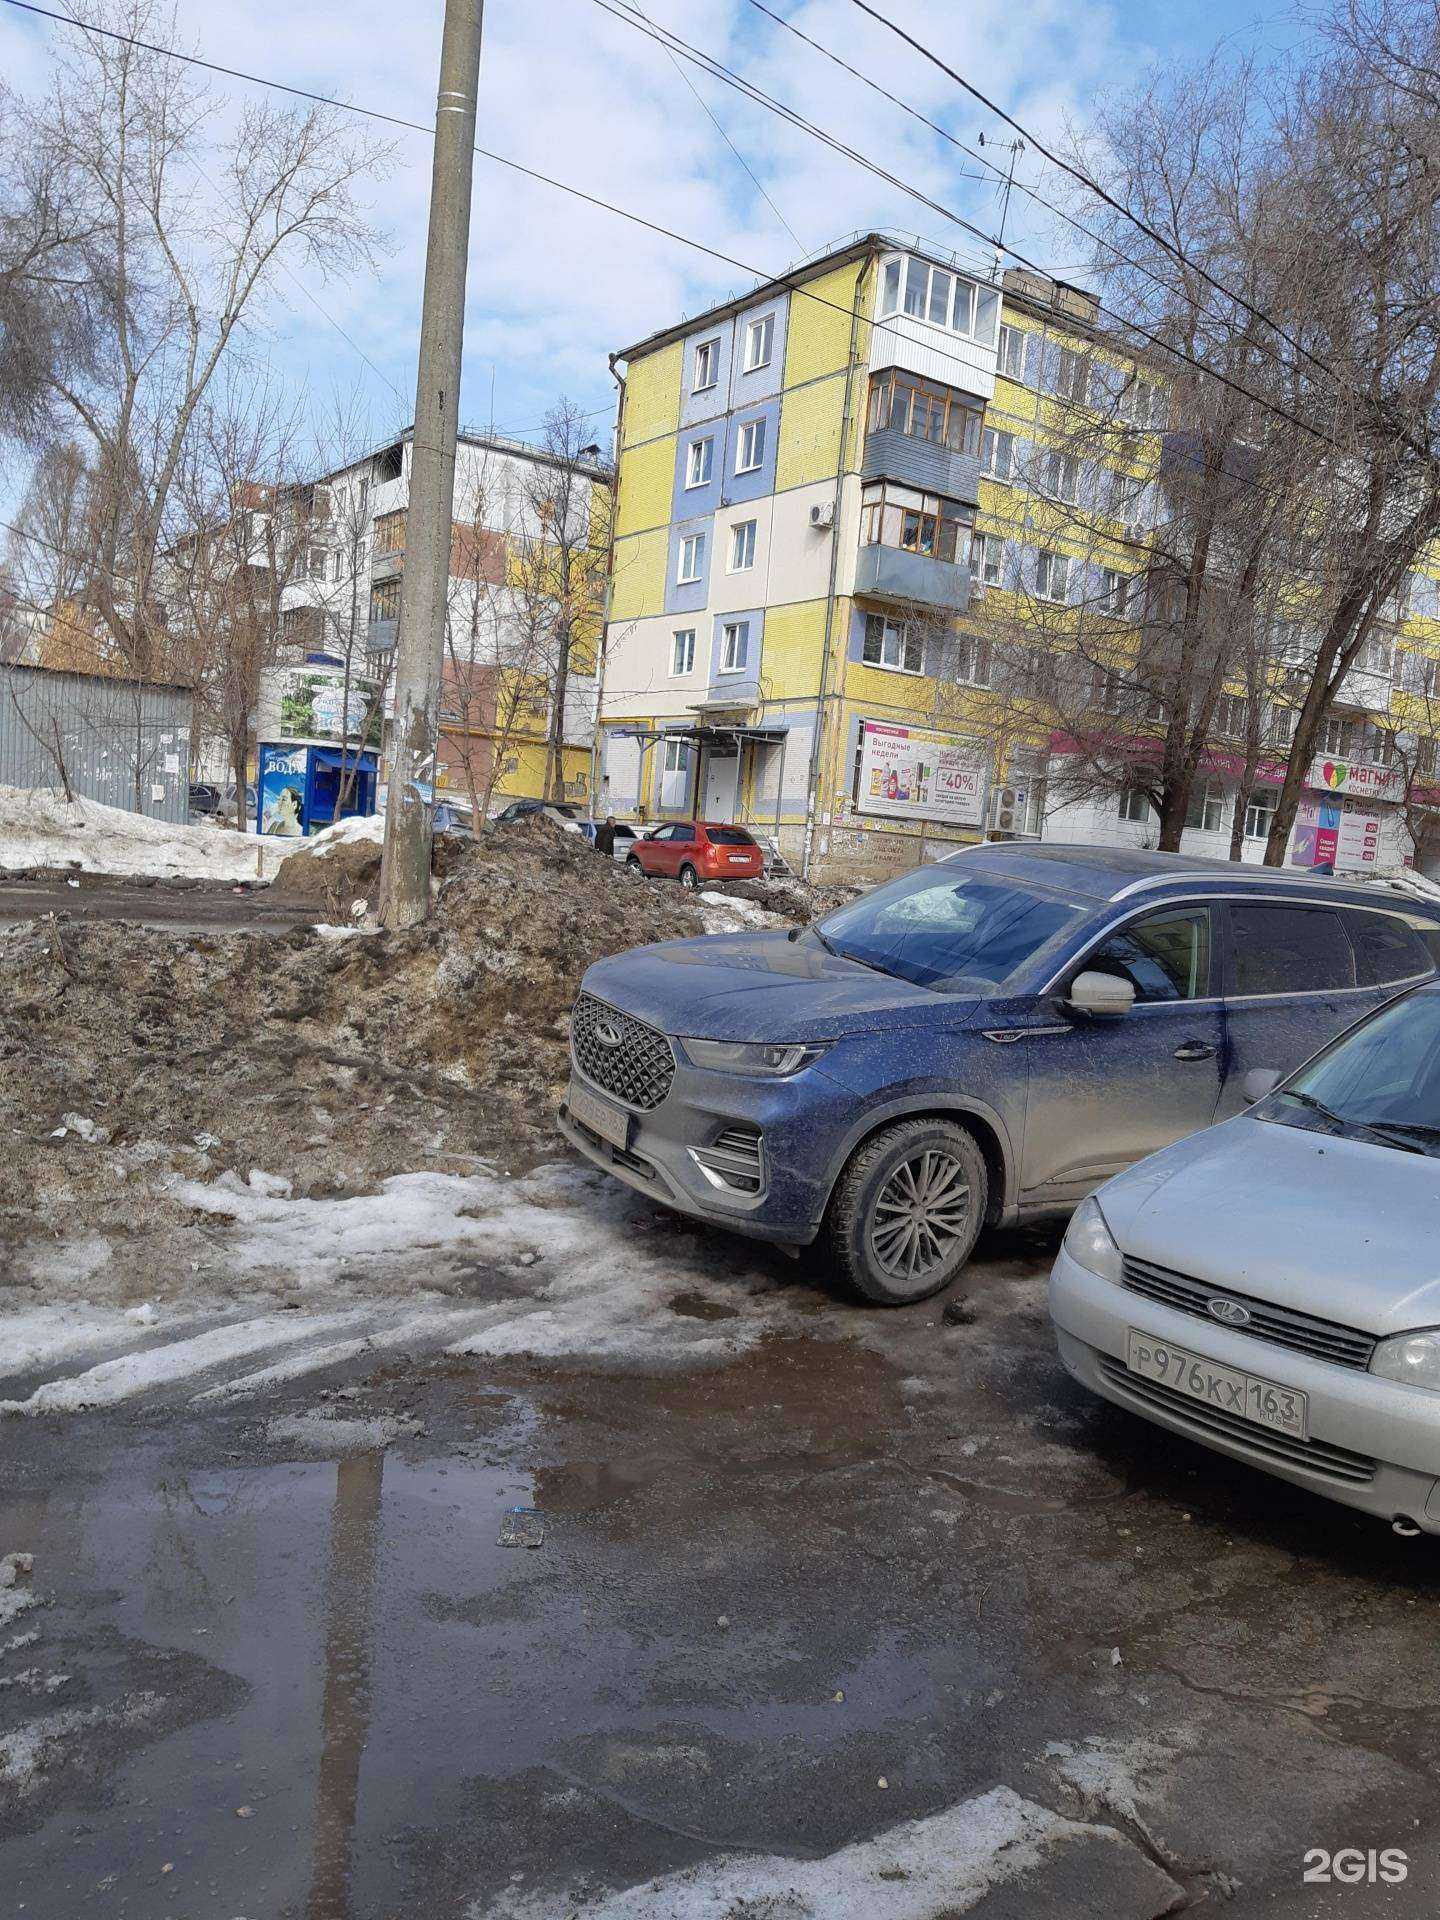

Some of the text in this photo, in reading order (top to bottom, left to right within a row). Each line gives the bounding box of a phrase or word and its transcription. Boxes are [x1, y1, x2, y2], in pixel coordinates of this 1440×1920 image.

[872, 737, 911, 752] Выгодные
[872, 749, 899, 759] недели
[941, 773, 974, 790] -40%
[1250, 1384, 1299, 1419] 163
